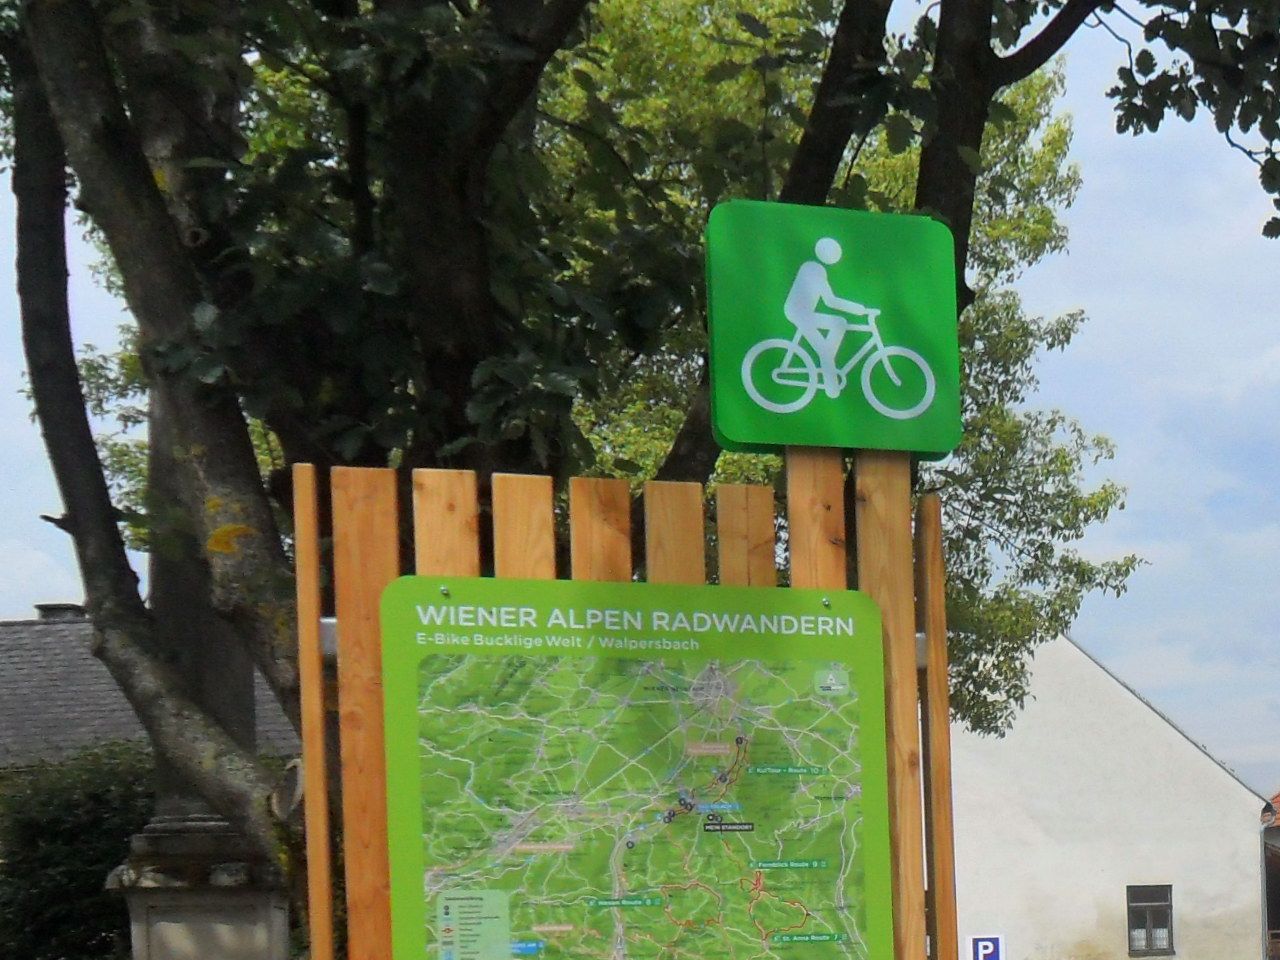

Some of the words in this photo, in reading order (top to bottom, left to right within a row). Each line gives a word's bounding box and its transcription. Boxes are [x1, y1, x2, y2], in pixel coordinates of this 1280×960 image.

[416, 604, 537, 628] WIENER
[547, 608, 643, 631] ALPEN
[653, 611, 854, 636] RADWANDERN
[416, 632, 469, 645] E-Bike
[474, 633, 543, 648] Bucklige
[545, 635, 582, 648] Welt
[586, 635, 594, 649] /
[599, 636, 699, 650] Walpersbach
